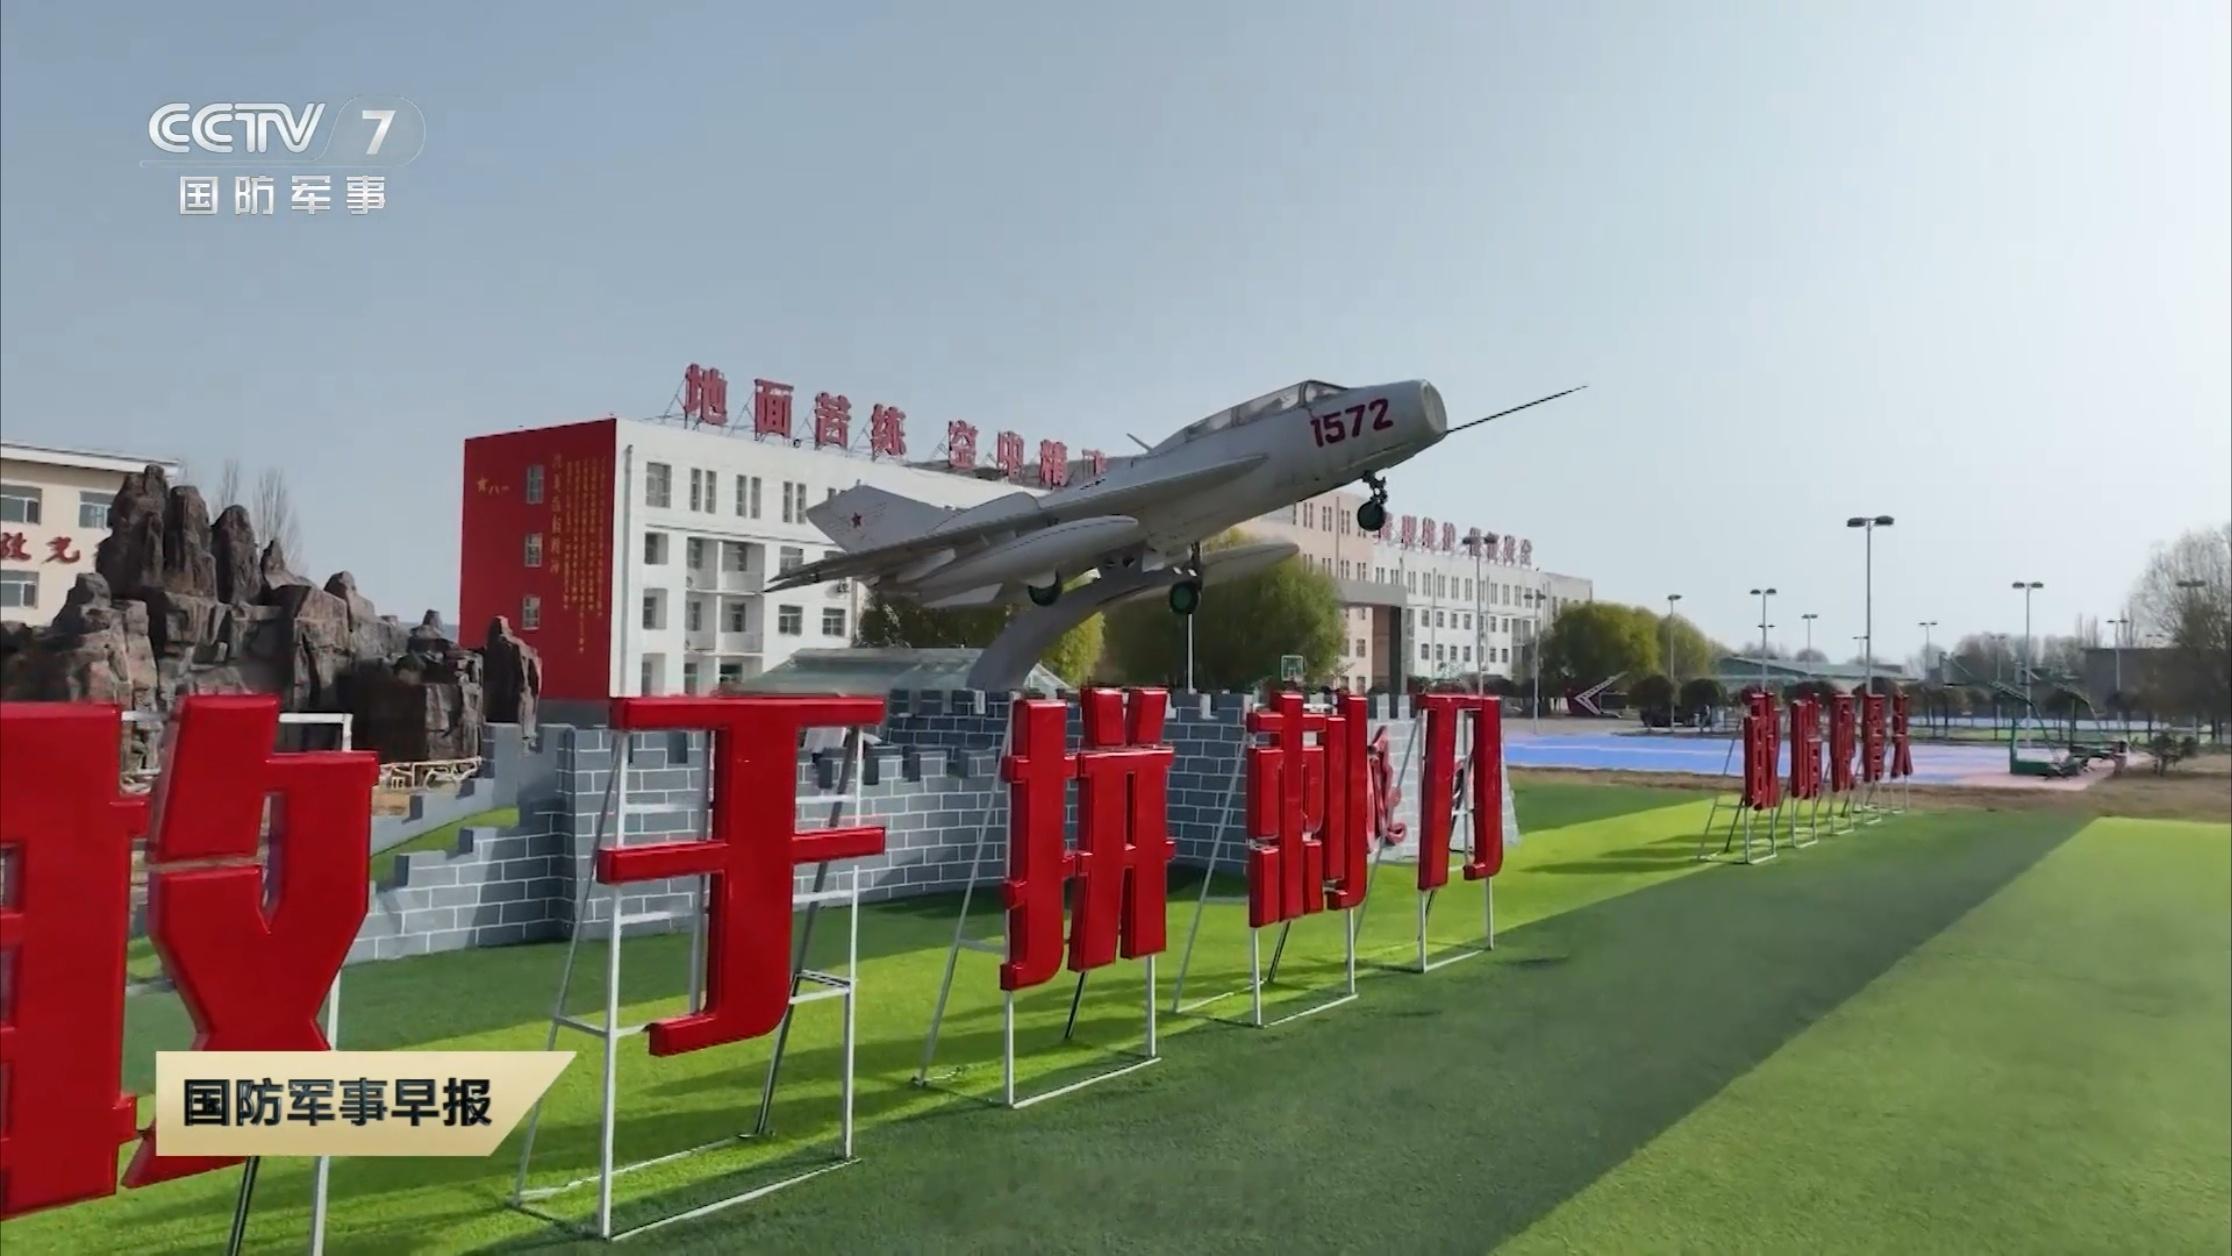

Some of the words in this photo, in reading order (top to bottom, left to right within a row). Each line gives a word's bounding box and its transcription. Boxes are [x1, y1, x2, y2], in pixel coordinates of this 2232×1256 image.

[684, 363, 907, 458] 地面苦练
[1310, 398, 1394, 448] 1572
